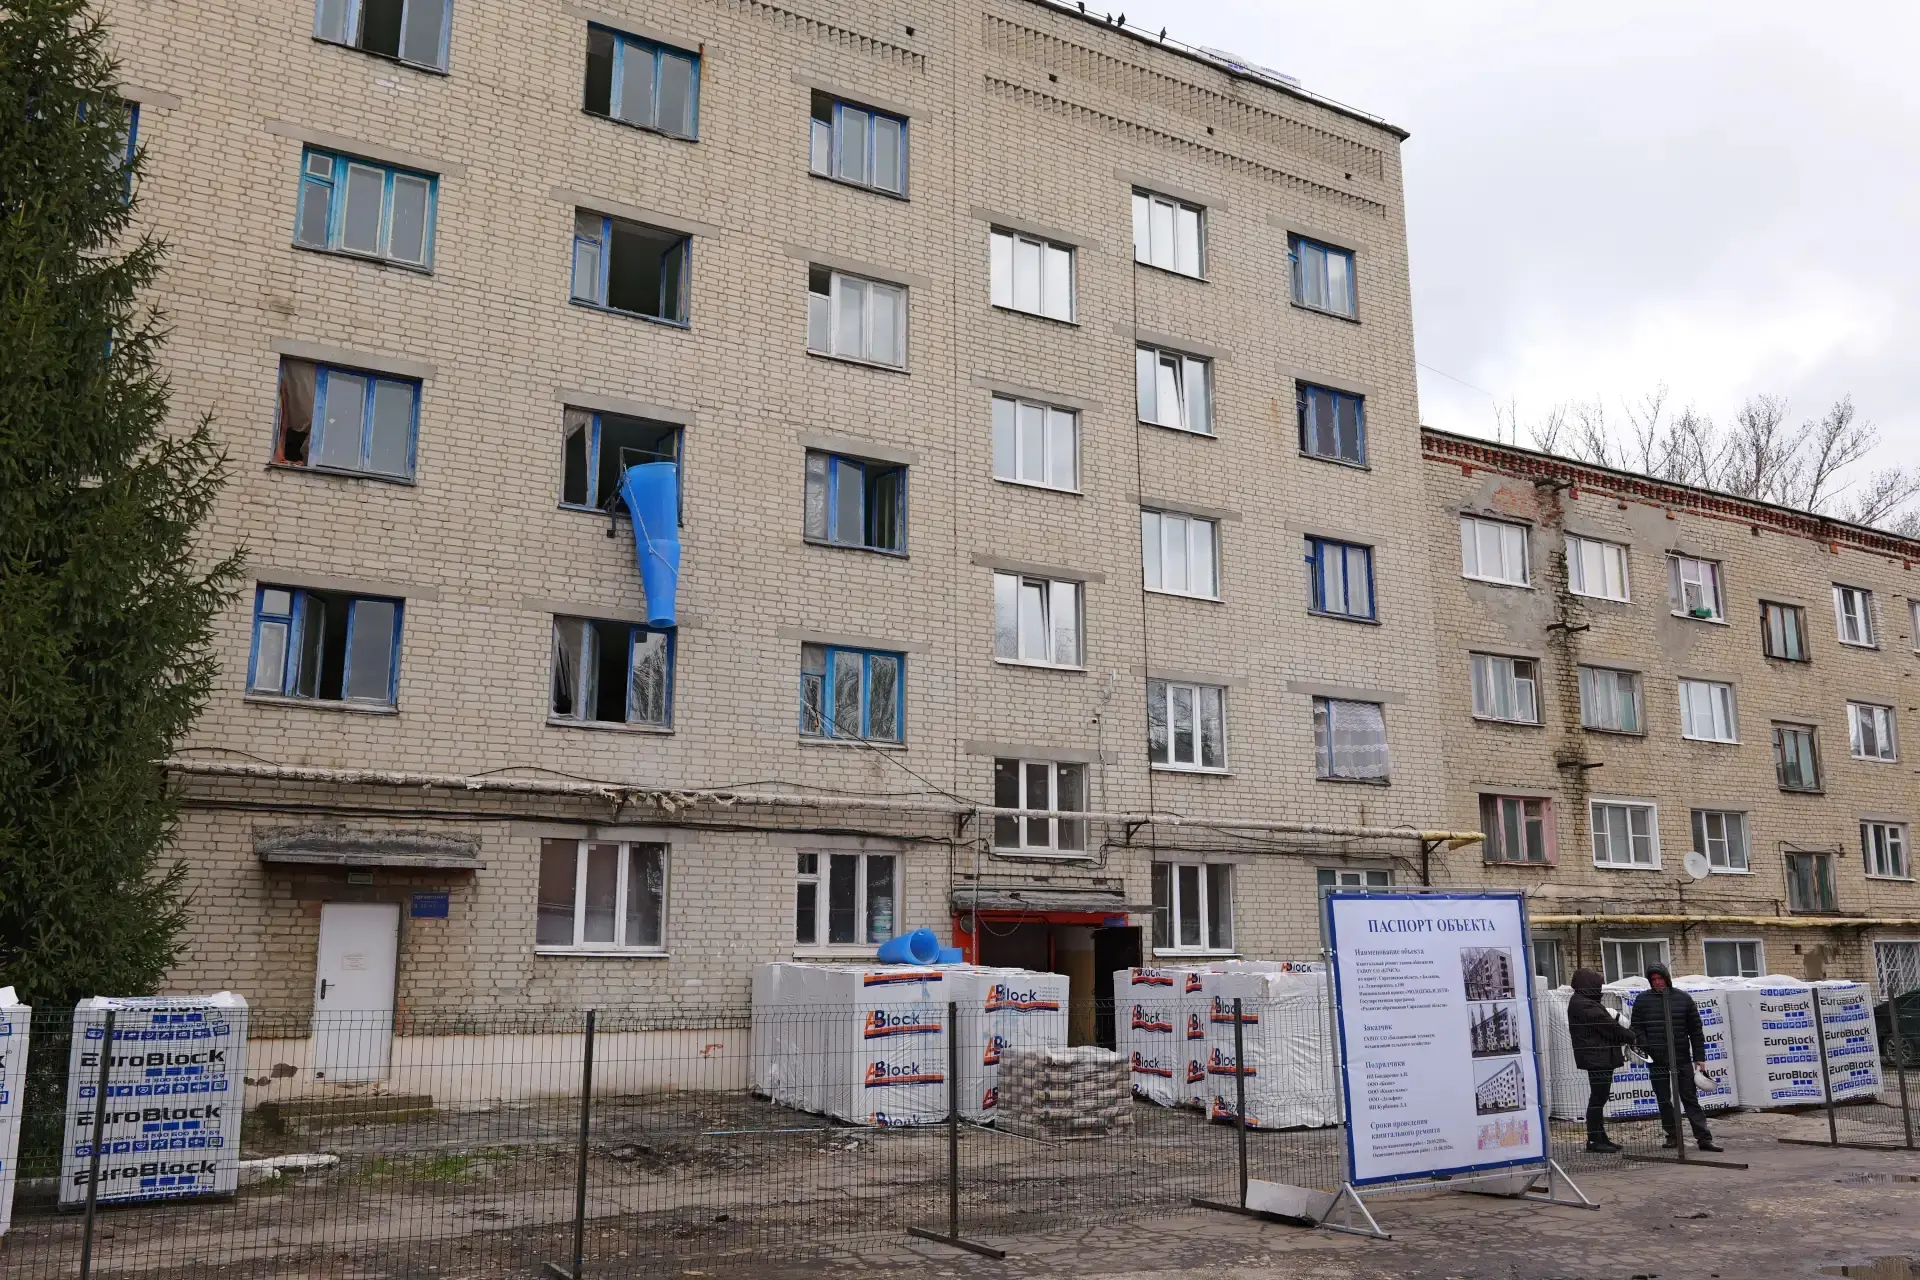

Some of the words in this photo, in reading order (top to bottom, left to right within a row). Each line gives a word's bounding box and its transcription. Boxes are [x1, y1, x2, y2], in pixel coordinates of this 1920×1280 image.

[1368, 919, 1433, 933] ПАСПОРТ
[1436, 918, 1495, 932] ОБЪЕКТА
[1760, 1001, 1809, 1012] EuroBlock
[1825, 1027, 1870, 1040] EuroBlock
[1764, 1036, 1815, 1046] EuroBlock
[1366, 1061, 1405, 1070] Подрядчики
[1830, 1060, 1874, 1075] EuroBlock
[1768, 1070, 1818, 1081] EuroBlock
[1608, 1089, 1655, 1102] EuroBloc
[1370, 1122, 1391, 1131] Сроки
[1393, 1119, 1428, 1129] проведения
[1371, 1130, 1414, 1139] капитального
[1416, 1128, 1441, 1137] ремонта
